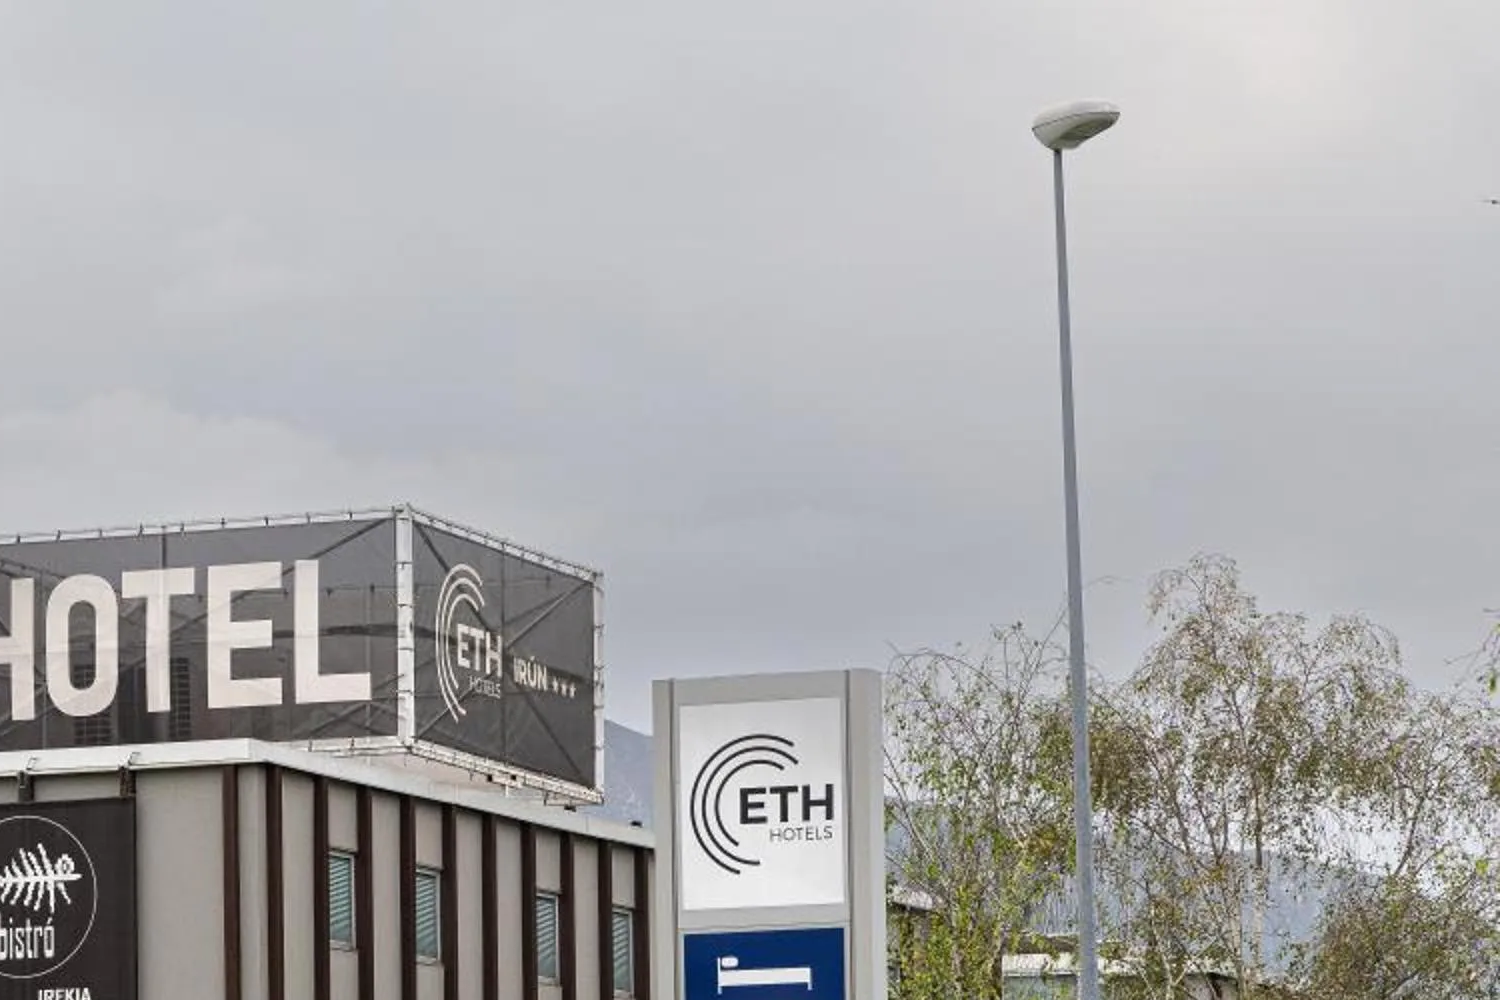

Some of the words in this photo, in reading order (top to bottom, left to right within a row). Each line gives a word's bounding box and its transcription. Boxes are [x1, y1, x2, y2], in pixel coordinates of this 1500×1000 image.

[457, 623, 502, 678] ETH
[469, 675, 501, 699] HOTELS
[513, 655, 548, 691] IRÚN
[740, 783, 834, 824] ETH
[769, 826, 833, 842] HOTELS
